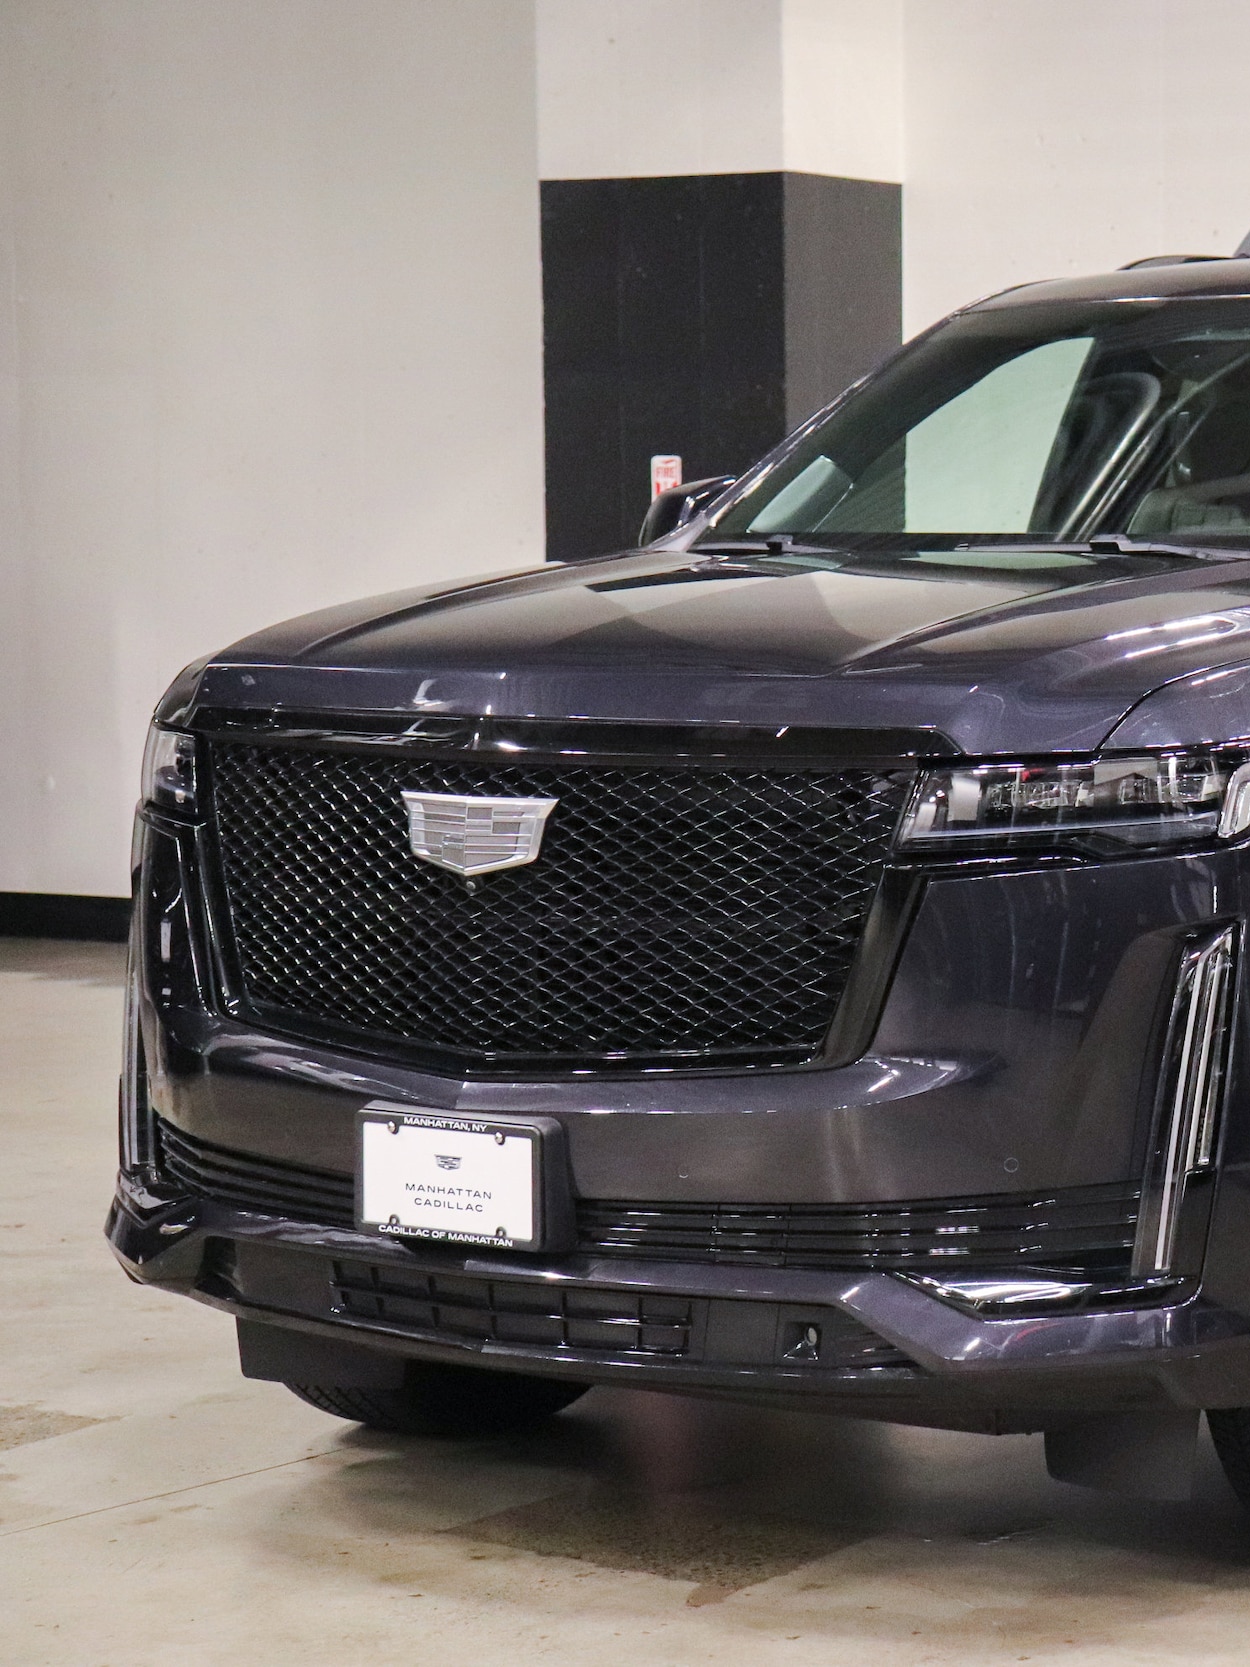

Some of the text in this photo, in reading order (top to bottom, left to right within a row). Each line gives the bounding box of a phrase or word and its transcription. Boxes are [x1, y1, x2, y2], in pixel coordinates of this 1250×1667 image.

[403, 1116, 487, 1132] MANHATTAN, NY
[405, 1183, 492, 1199] MANHATTAN
[414, 1197, 484, 1212] CADILLAC
[378, 1224, 513, 1247] CADILLAC OF MANHATTAN
